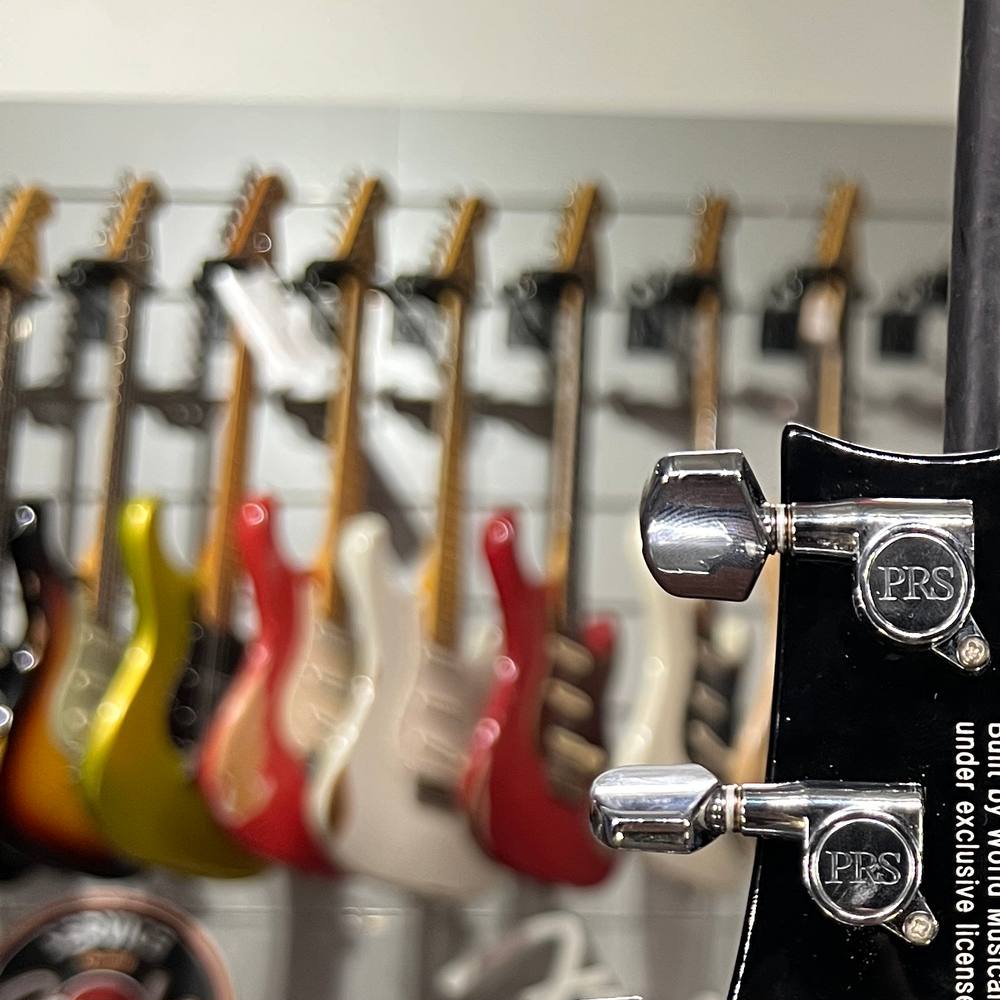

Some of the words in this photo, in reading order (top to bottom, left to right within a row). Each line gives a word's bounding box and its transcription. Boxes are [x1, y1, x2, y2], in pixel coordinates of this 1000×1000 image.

[877, 566, 955, 601] PRS
[955, 722, 980, 791] under
[825, 851, 901, 885] PRS
[955, 801, 980, 912] exclusive
